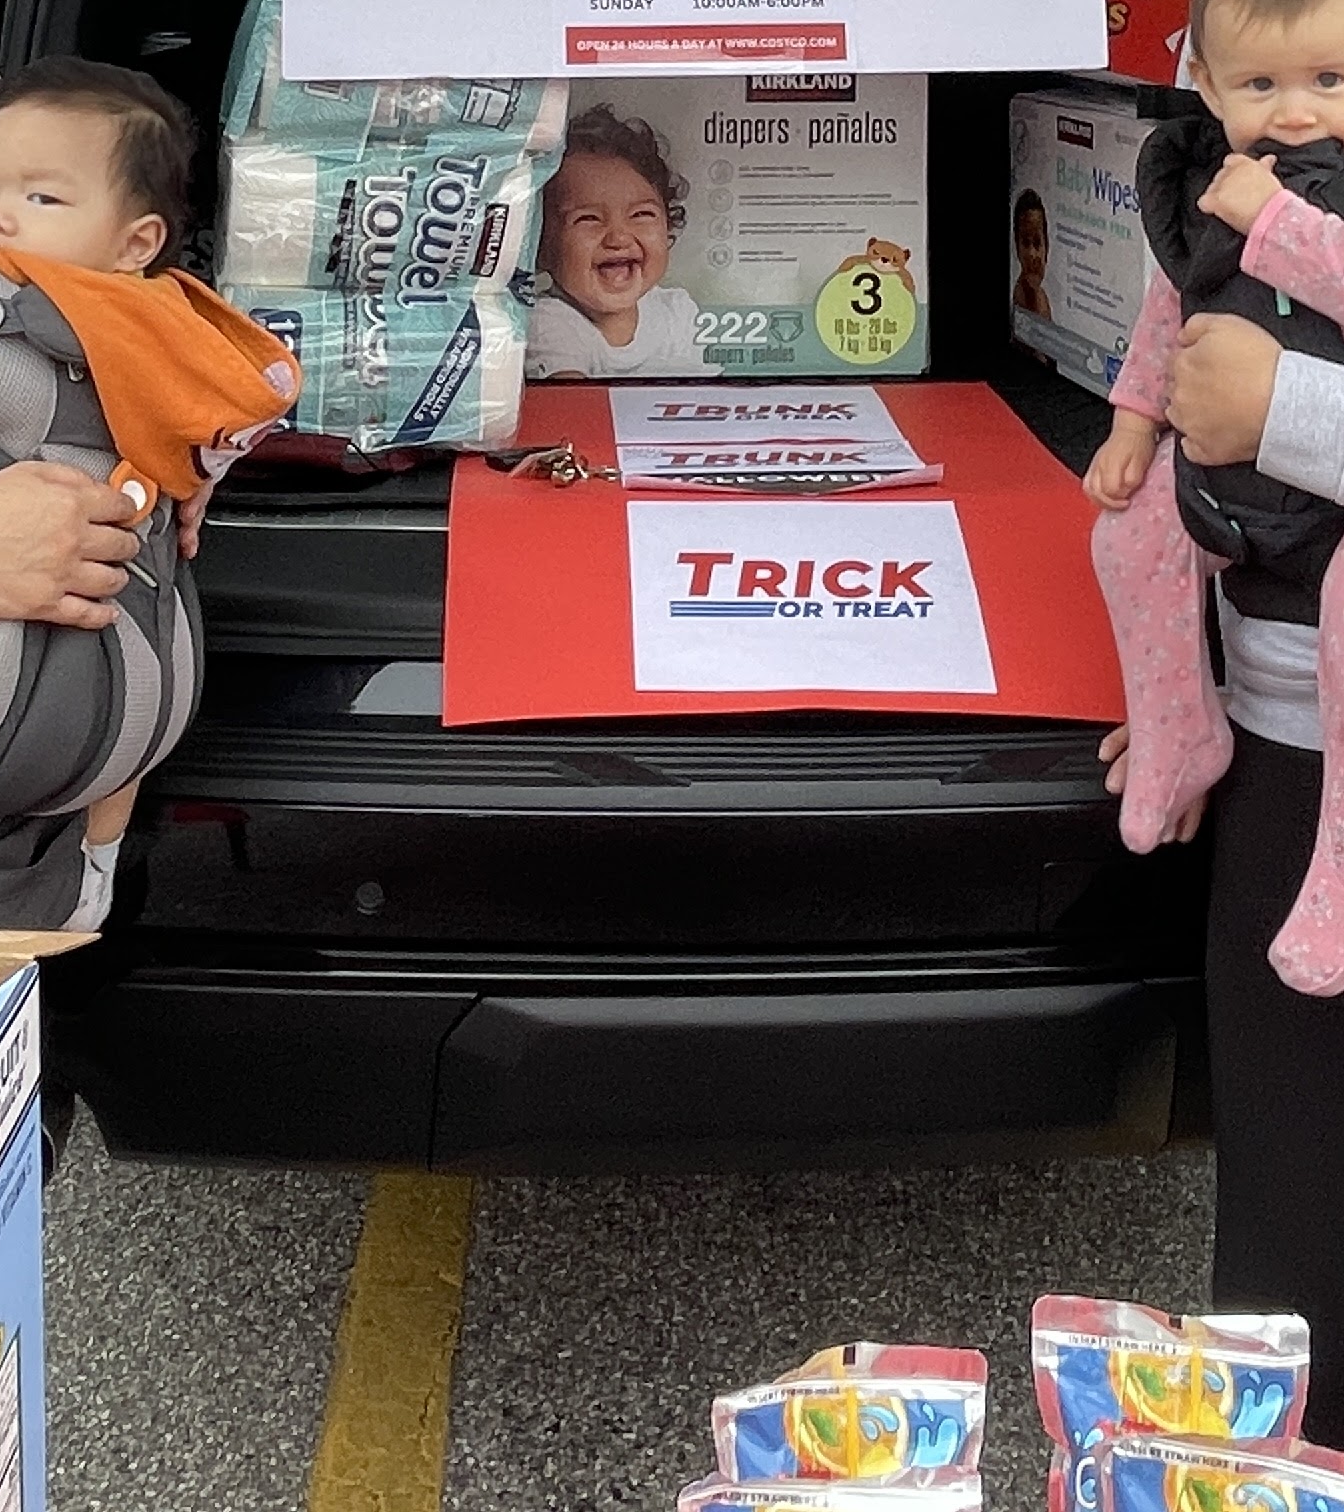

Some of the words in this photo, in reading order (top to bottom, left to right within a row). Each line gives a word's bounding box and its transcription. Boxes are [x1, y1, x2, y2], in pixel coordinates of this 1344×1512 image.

[576, 40, 610, 52] OPEN
[612, 40, 625, 51] 24
[628, 39, 668, 51] HOURS
[682, 39, 705, 50] DAY
[707, 38, 722, 50] AT
[725, 36, 838, 49] WWW.COSTCO.COM
[752, 75, 853, 90] KIRKLAND
[704, 111, 790, 149] diapers
[809, 111, 897, 149] pañales
[398, 155, 490, 308] Towel
[450, 191, 479, 281] PREMIUM
[482, 206, 507, 276] KIRKLAND
[850, 272, 882, 316] 3
[695, 312, 768, 344] 222
[654, 403, 859, 418] TRUNK
[661, 452, 868, 466] TRUNK
[677, 552, 934, 598] TRICK
[778, 601, 824, 618] OR
[833, 601, 934, 618] TREAT
